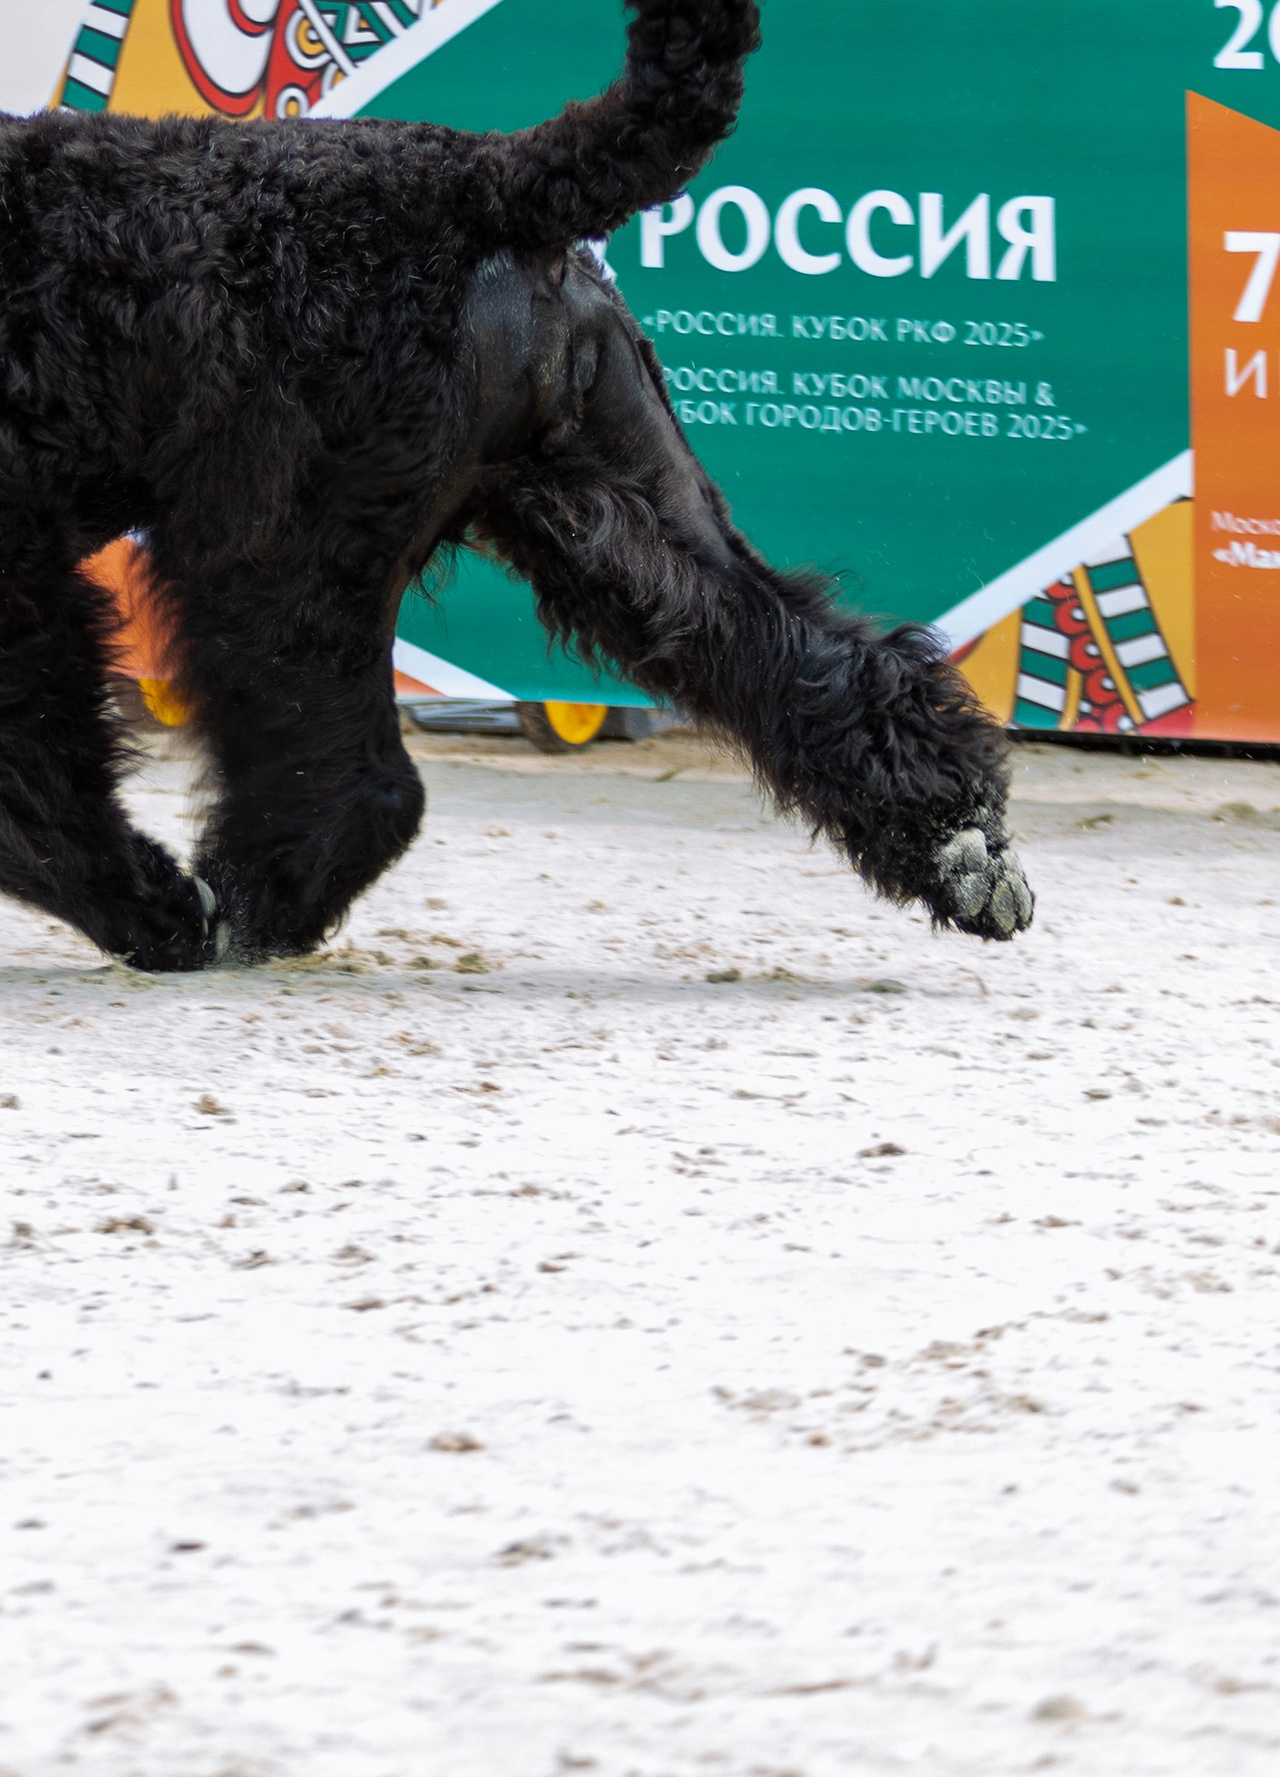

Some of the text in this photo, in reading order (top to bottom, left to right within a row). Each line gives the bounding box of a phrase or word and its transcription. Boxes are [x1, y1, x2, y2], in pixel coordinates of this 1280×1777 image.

[640, 185, 1057, 282] РОССИЯ
[1224, 230, 1280, 323] 7
[792, 313, 890, 342] КУБОК
[896, 316, 957, 345] РКФ
[963, 320, 1046, 347] 2025»
[792, 371, 890, 400] КУБОК
[896, 376, 1027, 406] МОСКВЫ
[1034, 381, 1058, 408] &
[1224, 347, 1280, 399] И
[745, 402, 999, 438] ГОРОДОВ-ГЕРОЕВ
[1006, 411, 1089, 441] 2025»
